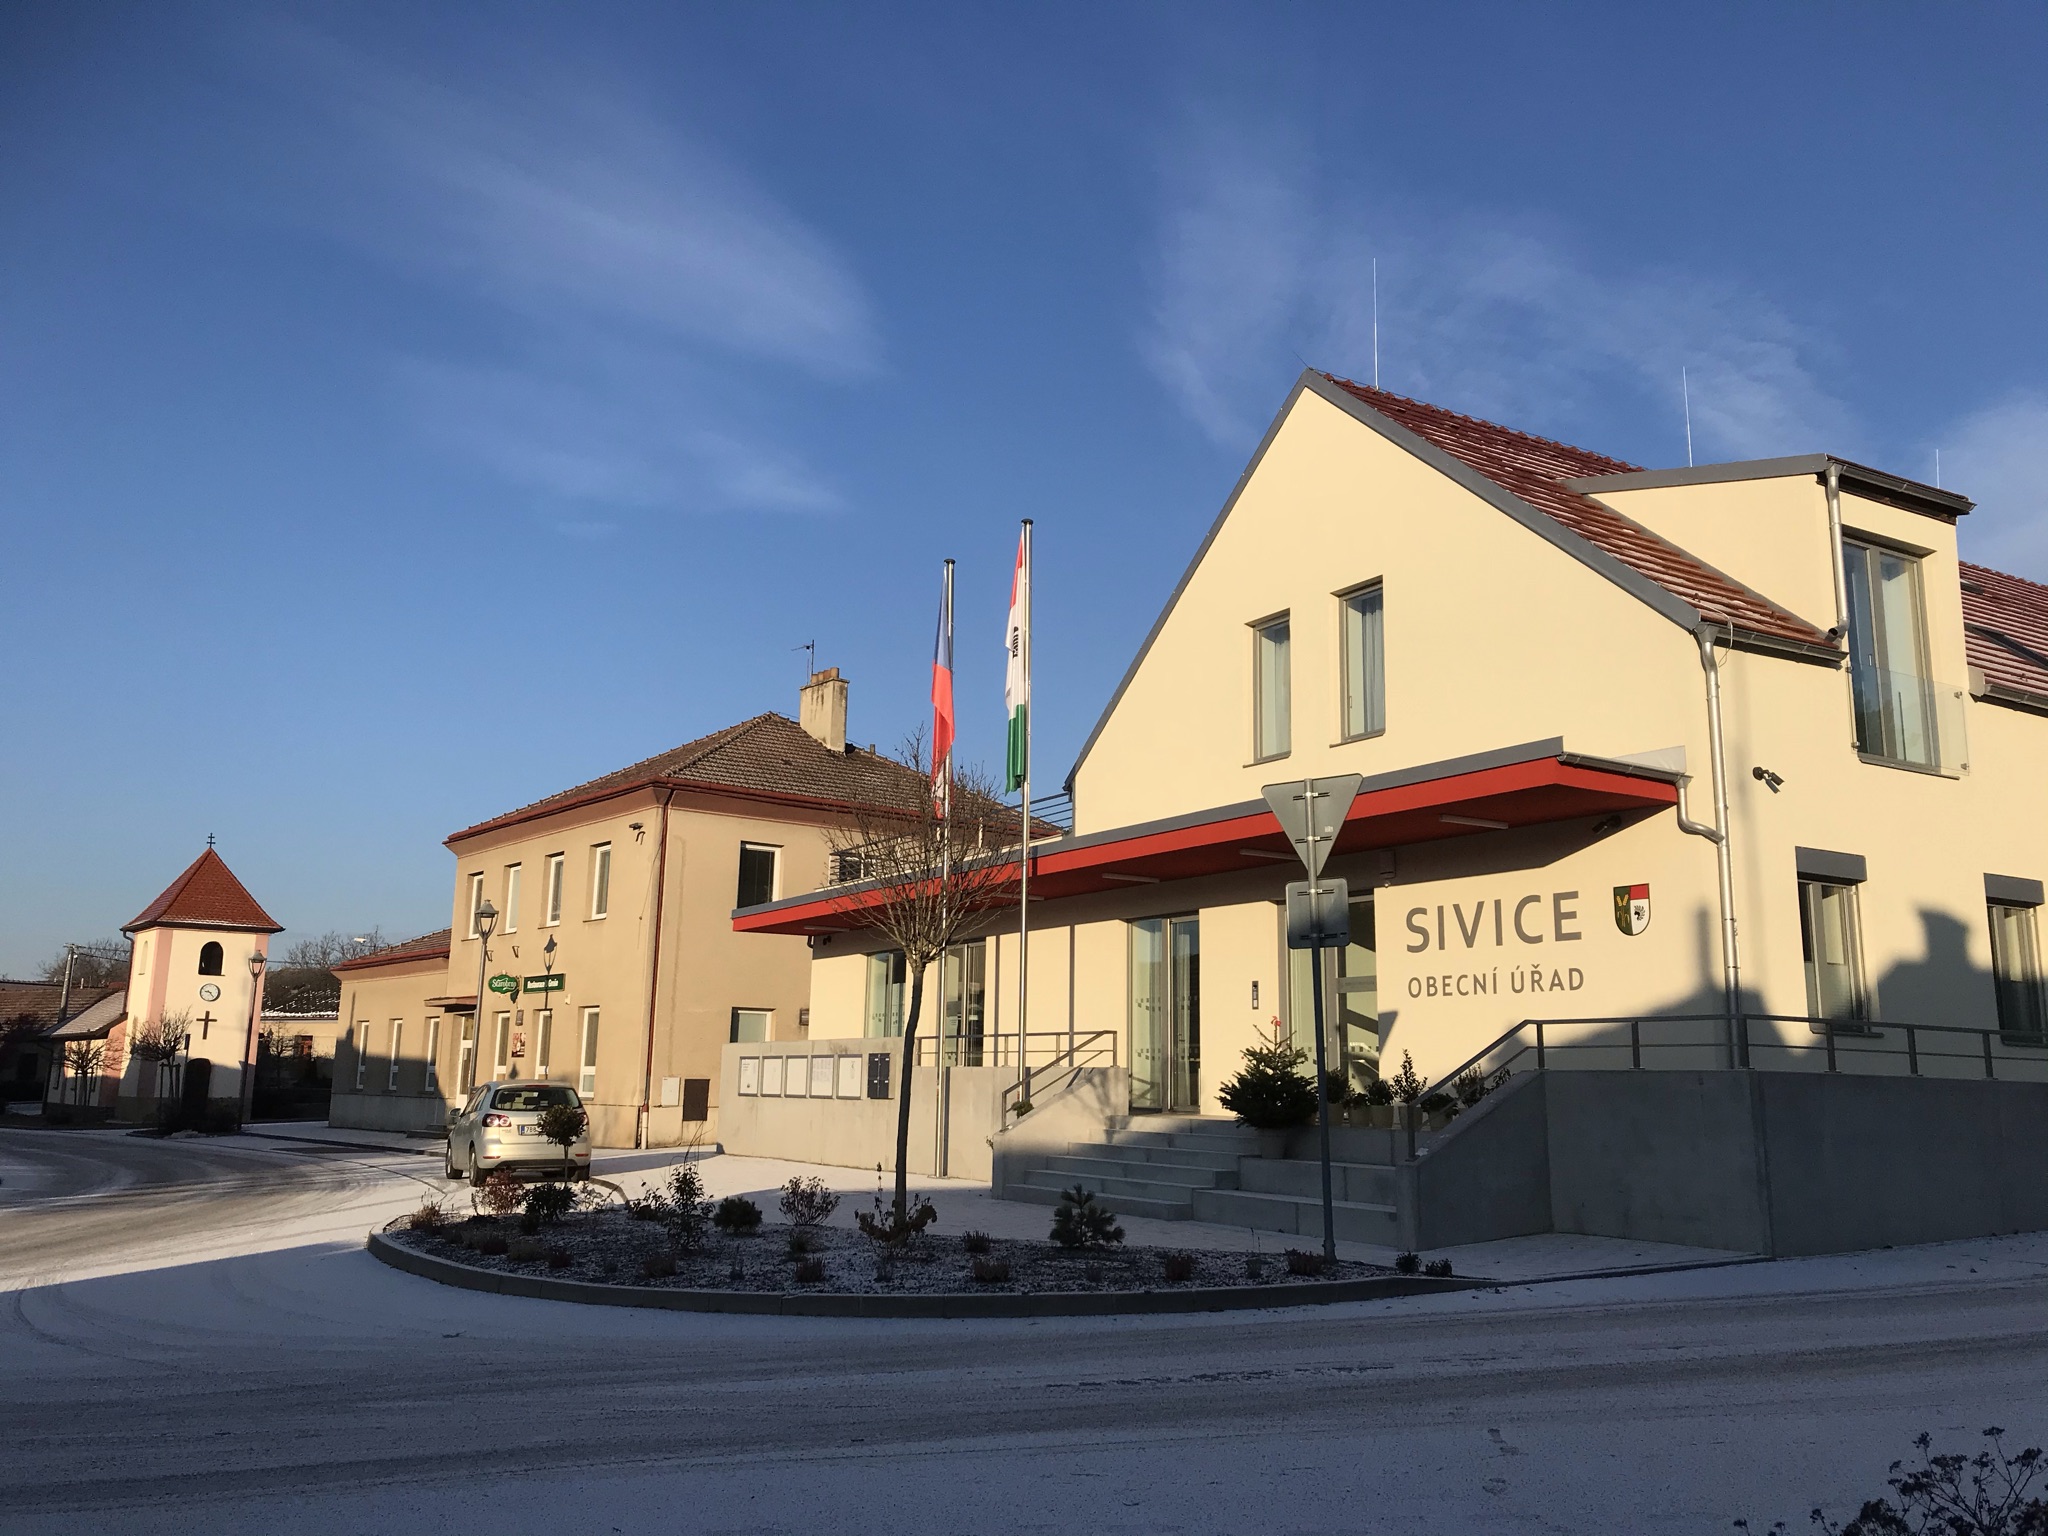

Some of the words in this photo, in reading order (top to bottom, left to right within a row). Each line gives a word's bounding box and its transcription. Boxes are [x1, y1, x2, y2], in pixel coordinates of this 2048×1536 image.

[1405, 890, 1582, 953] SIVICE
[1407, 967, 1498, 998] OBECNÍ
[1510, 963, 1584, 994] ÚŘAD
